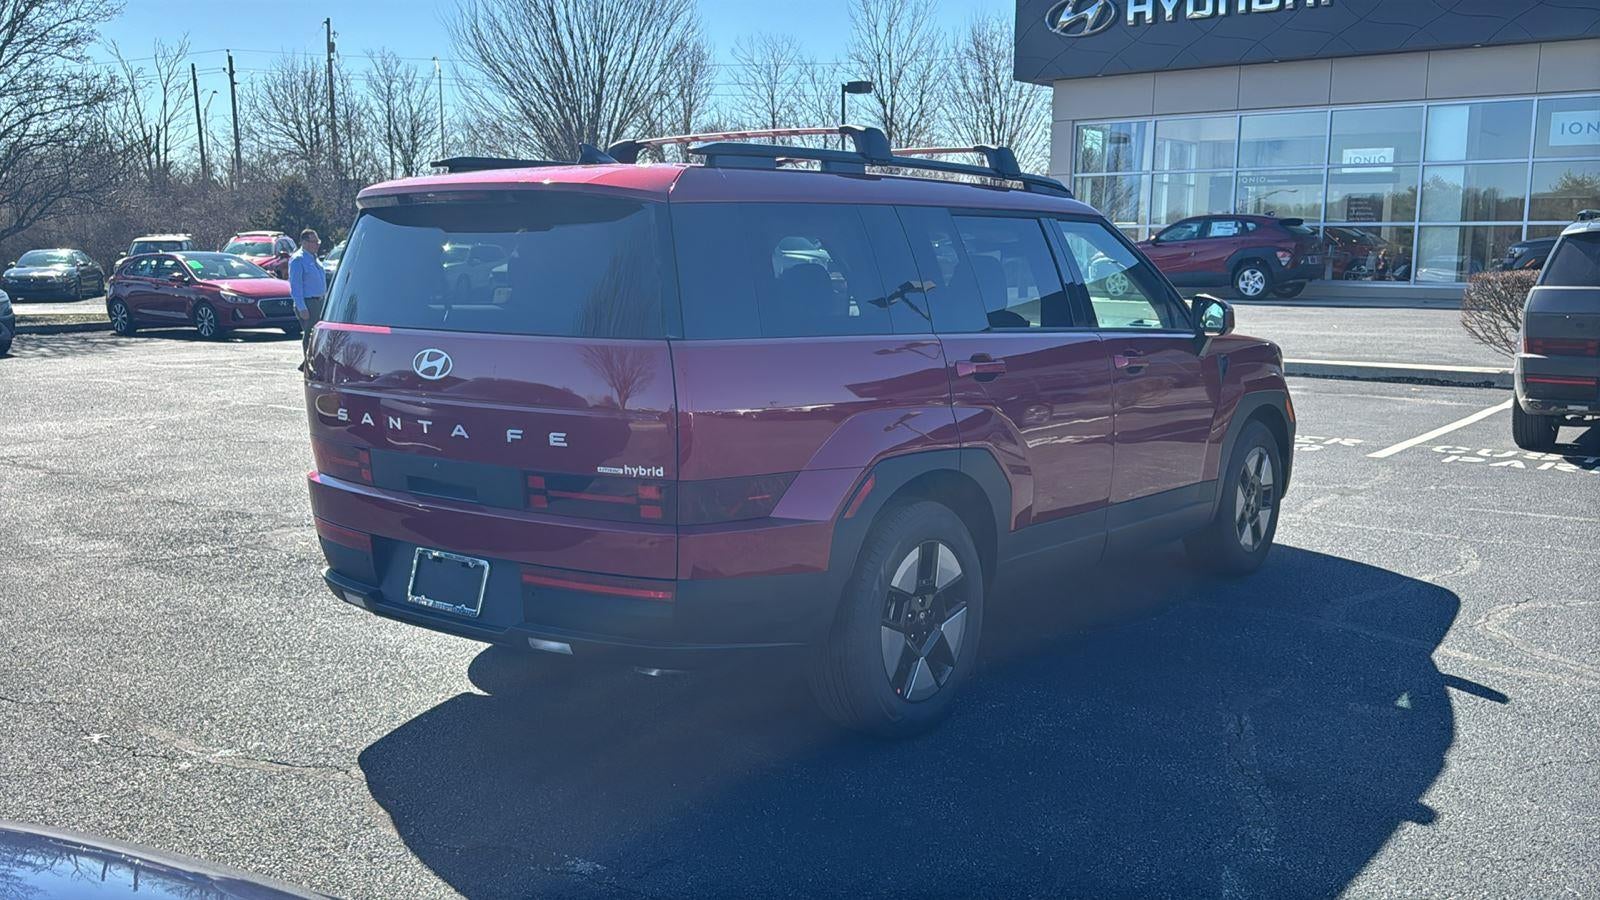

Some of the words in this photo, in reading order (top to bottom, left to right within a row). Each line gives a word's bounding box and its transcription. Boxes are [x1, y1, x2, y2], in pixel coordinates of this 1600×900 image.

[1126, 0, 1330, 25] HYUN
[337, 408, 470, 439] SANTA
[506, 429, 568, 447] FE
[623, 464, 664, 478] hybrid
